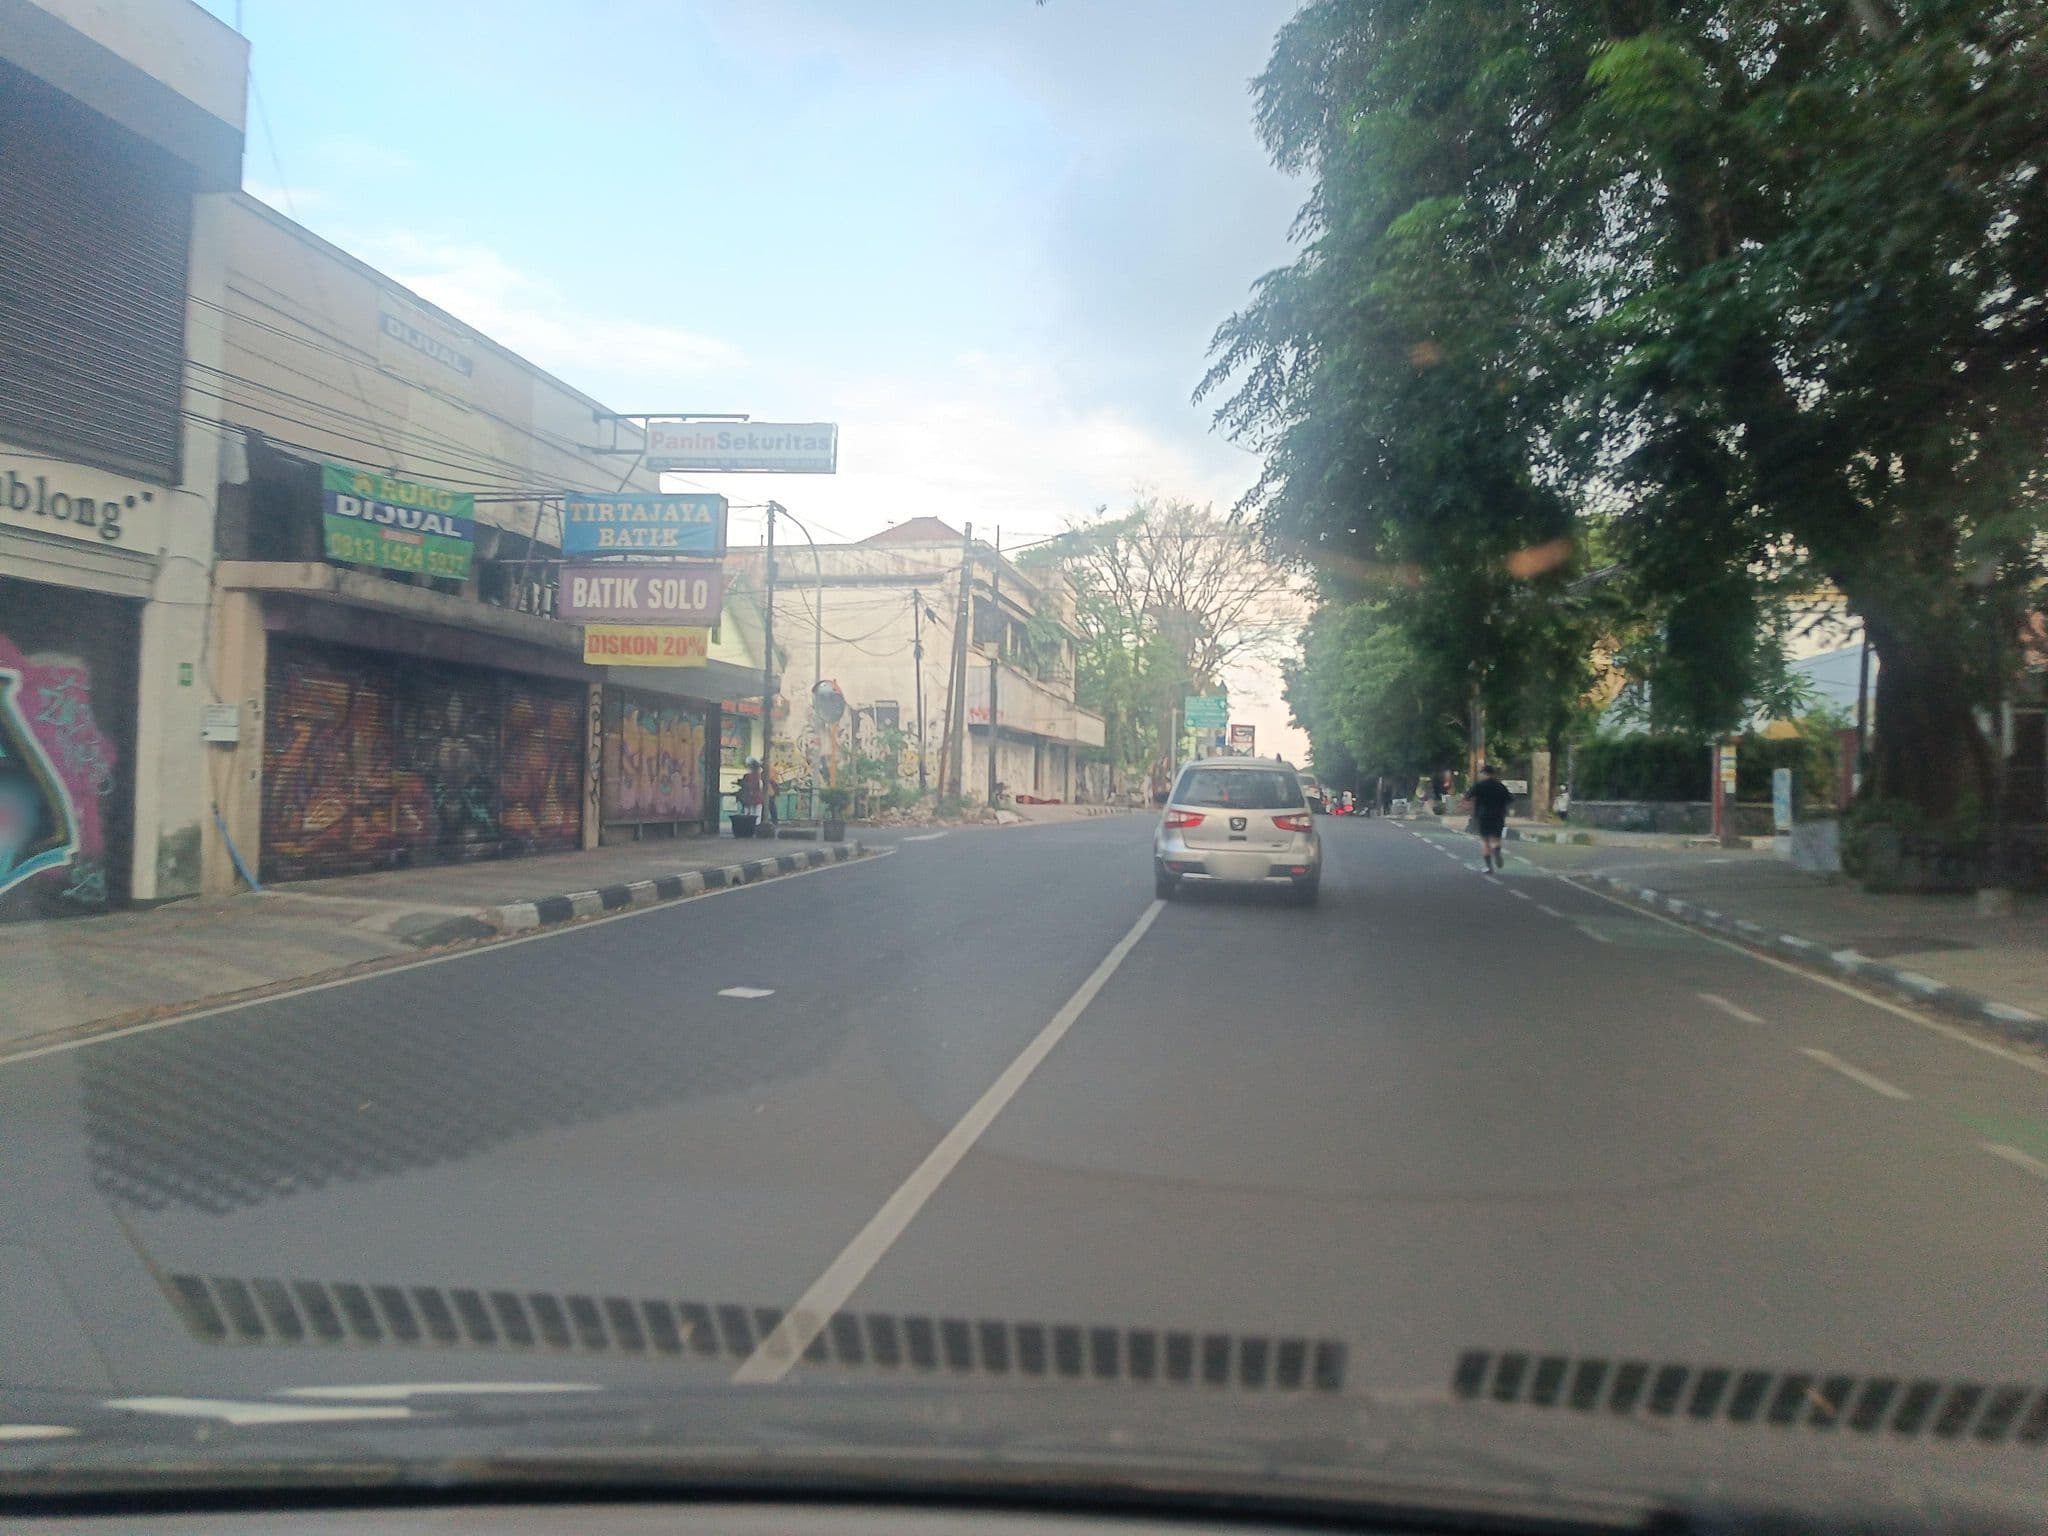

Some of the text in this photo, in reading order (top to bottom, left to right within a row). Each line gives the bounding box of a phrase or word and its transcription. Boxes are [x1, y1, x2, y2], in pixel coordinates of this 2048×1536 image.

[651, 431, 829, 451] PaninSekuritas
[0, 469, 121, 540] blong
[381, 478, 453, 511] RUKO
[336, 494, 463, 538] DIJUAL
[570, 502, 712, 523] TIRTAJAYA
[598, 527, 680, 547] BATIK
[572, 577, 708, 610] BATIK SOLO
[587, 634, 706, 657] DISKON 20%
